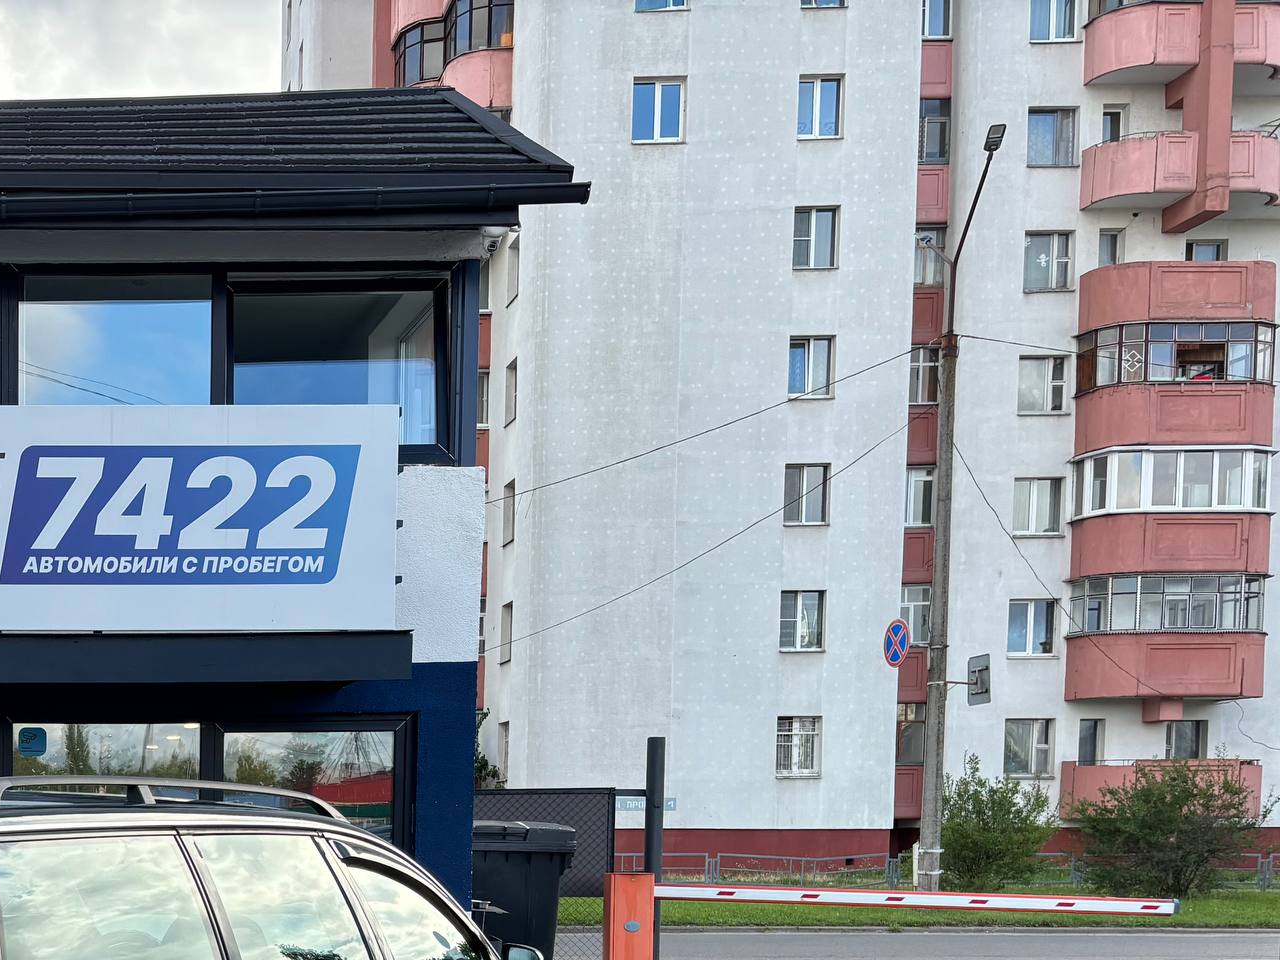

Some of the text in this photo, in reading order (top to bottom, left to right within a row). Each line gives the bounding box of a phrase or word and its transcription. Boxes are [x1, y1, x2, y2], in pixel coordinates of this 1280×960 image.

[29, 454, 338, 552] 7422
[22, 555, 325, 574] АВТОМОБИЛИ С ПРОБЕГОМ
